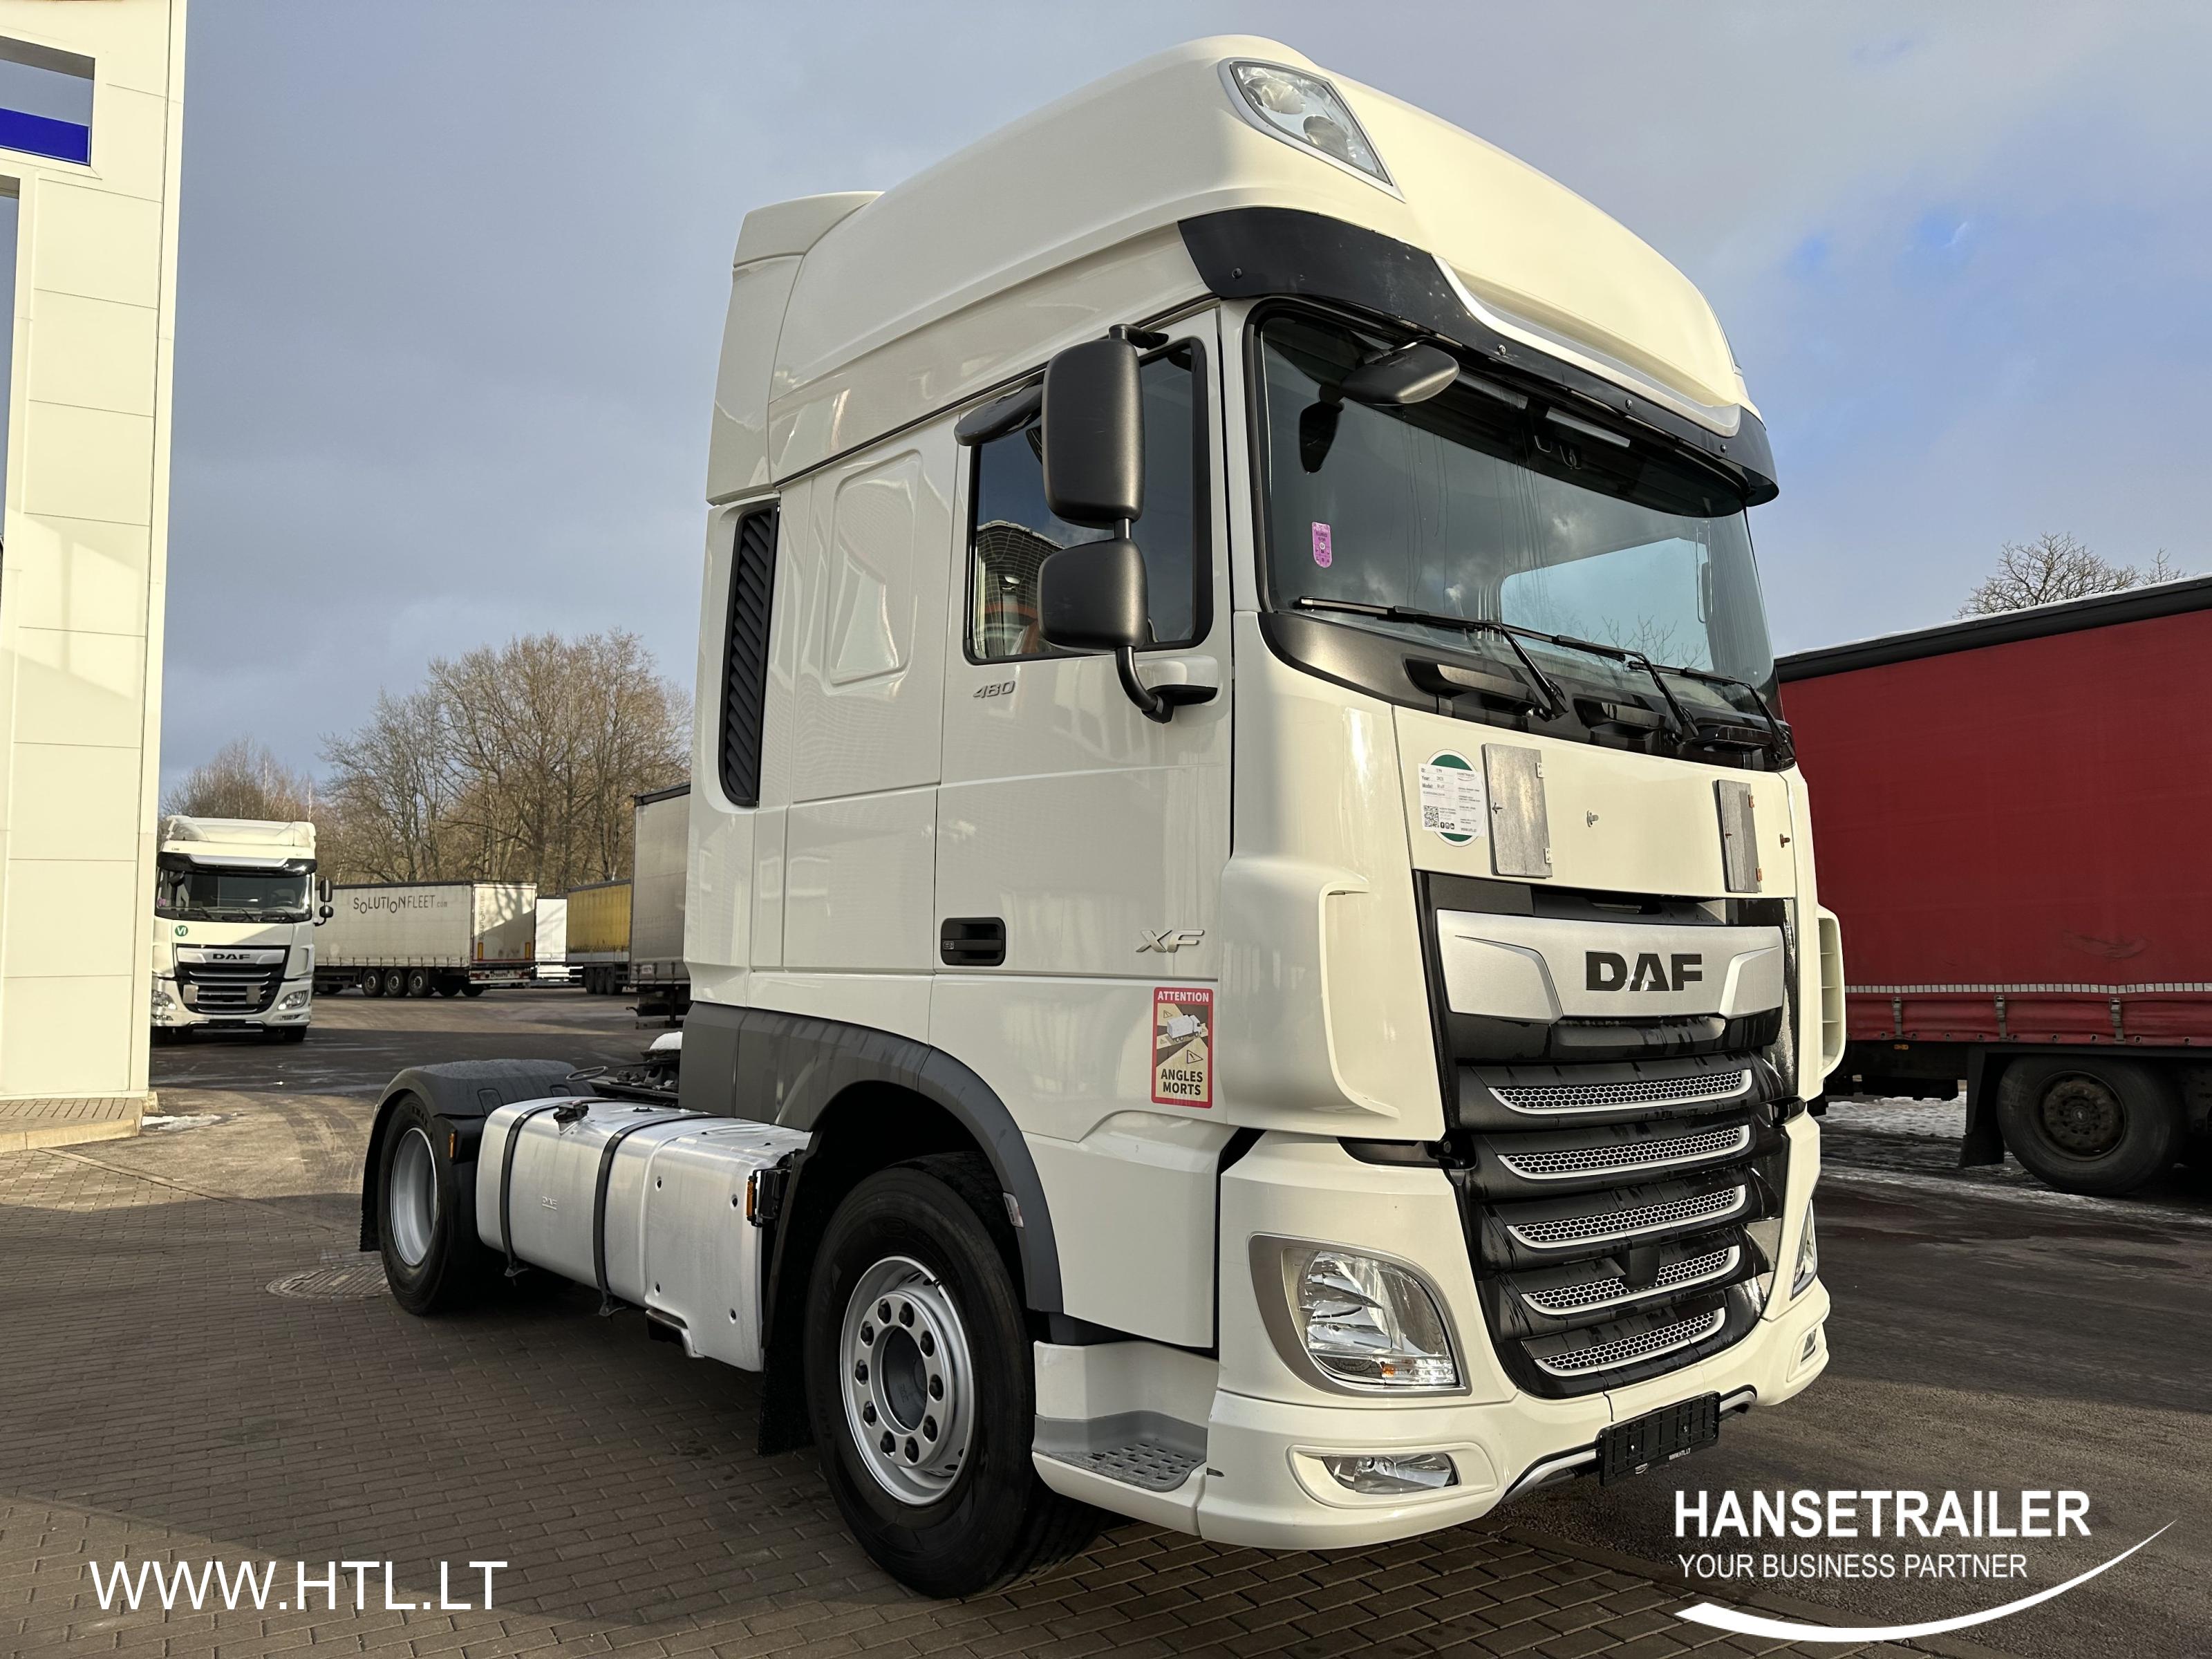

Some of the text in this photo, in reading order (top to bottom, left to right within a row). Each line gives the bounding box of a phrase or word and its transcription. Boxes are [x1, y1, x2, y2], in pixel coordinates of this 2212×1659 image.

[973, 680, 1016, 699] 480
[176, 926, 187, 935] VI
[1136, 929, 1205, 953] XF
[1586, 950, 1703, 991] DAF
[1157, 991, 1210, 1002] ATTENTION
[1161, 1069, 1203, 1082] ANGLES
[1163, 1082, 1201, 1096] MORTS
